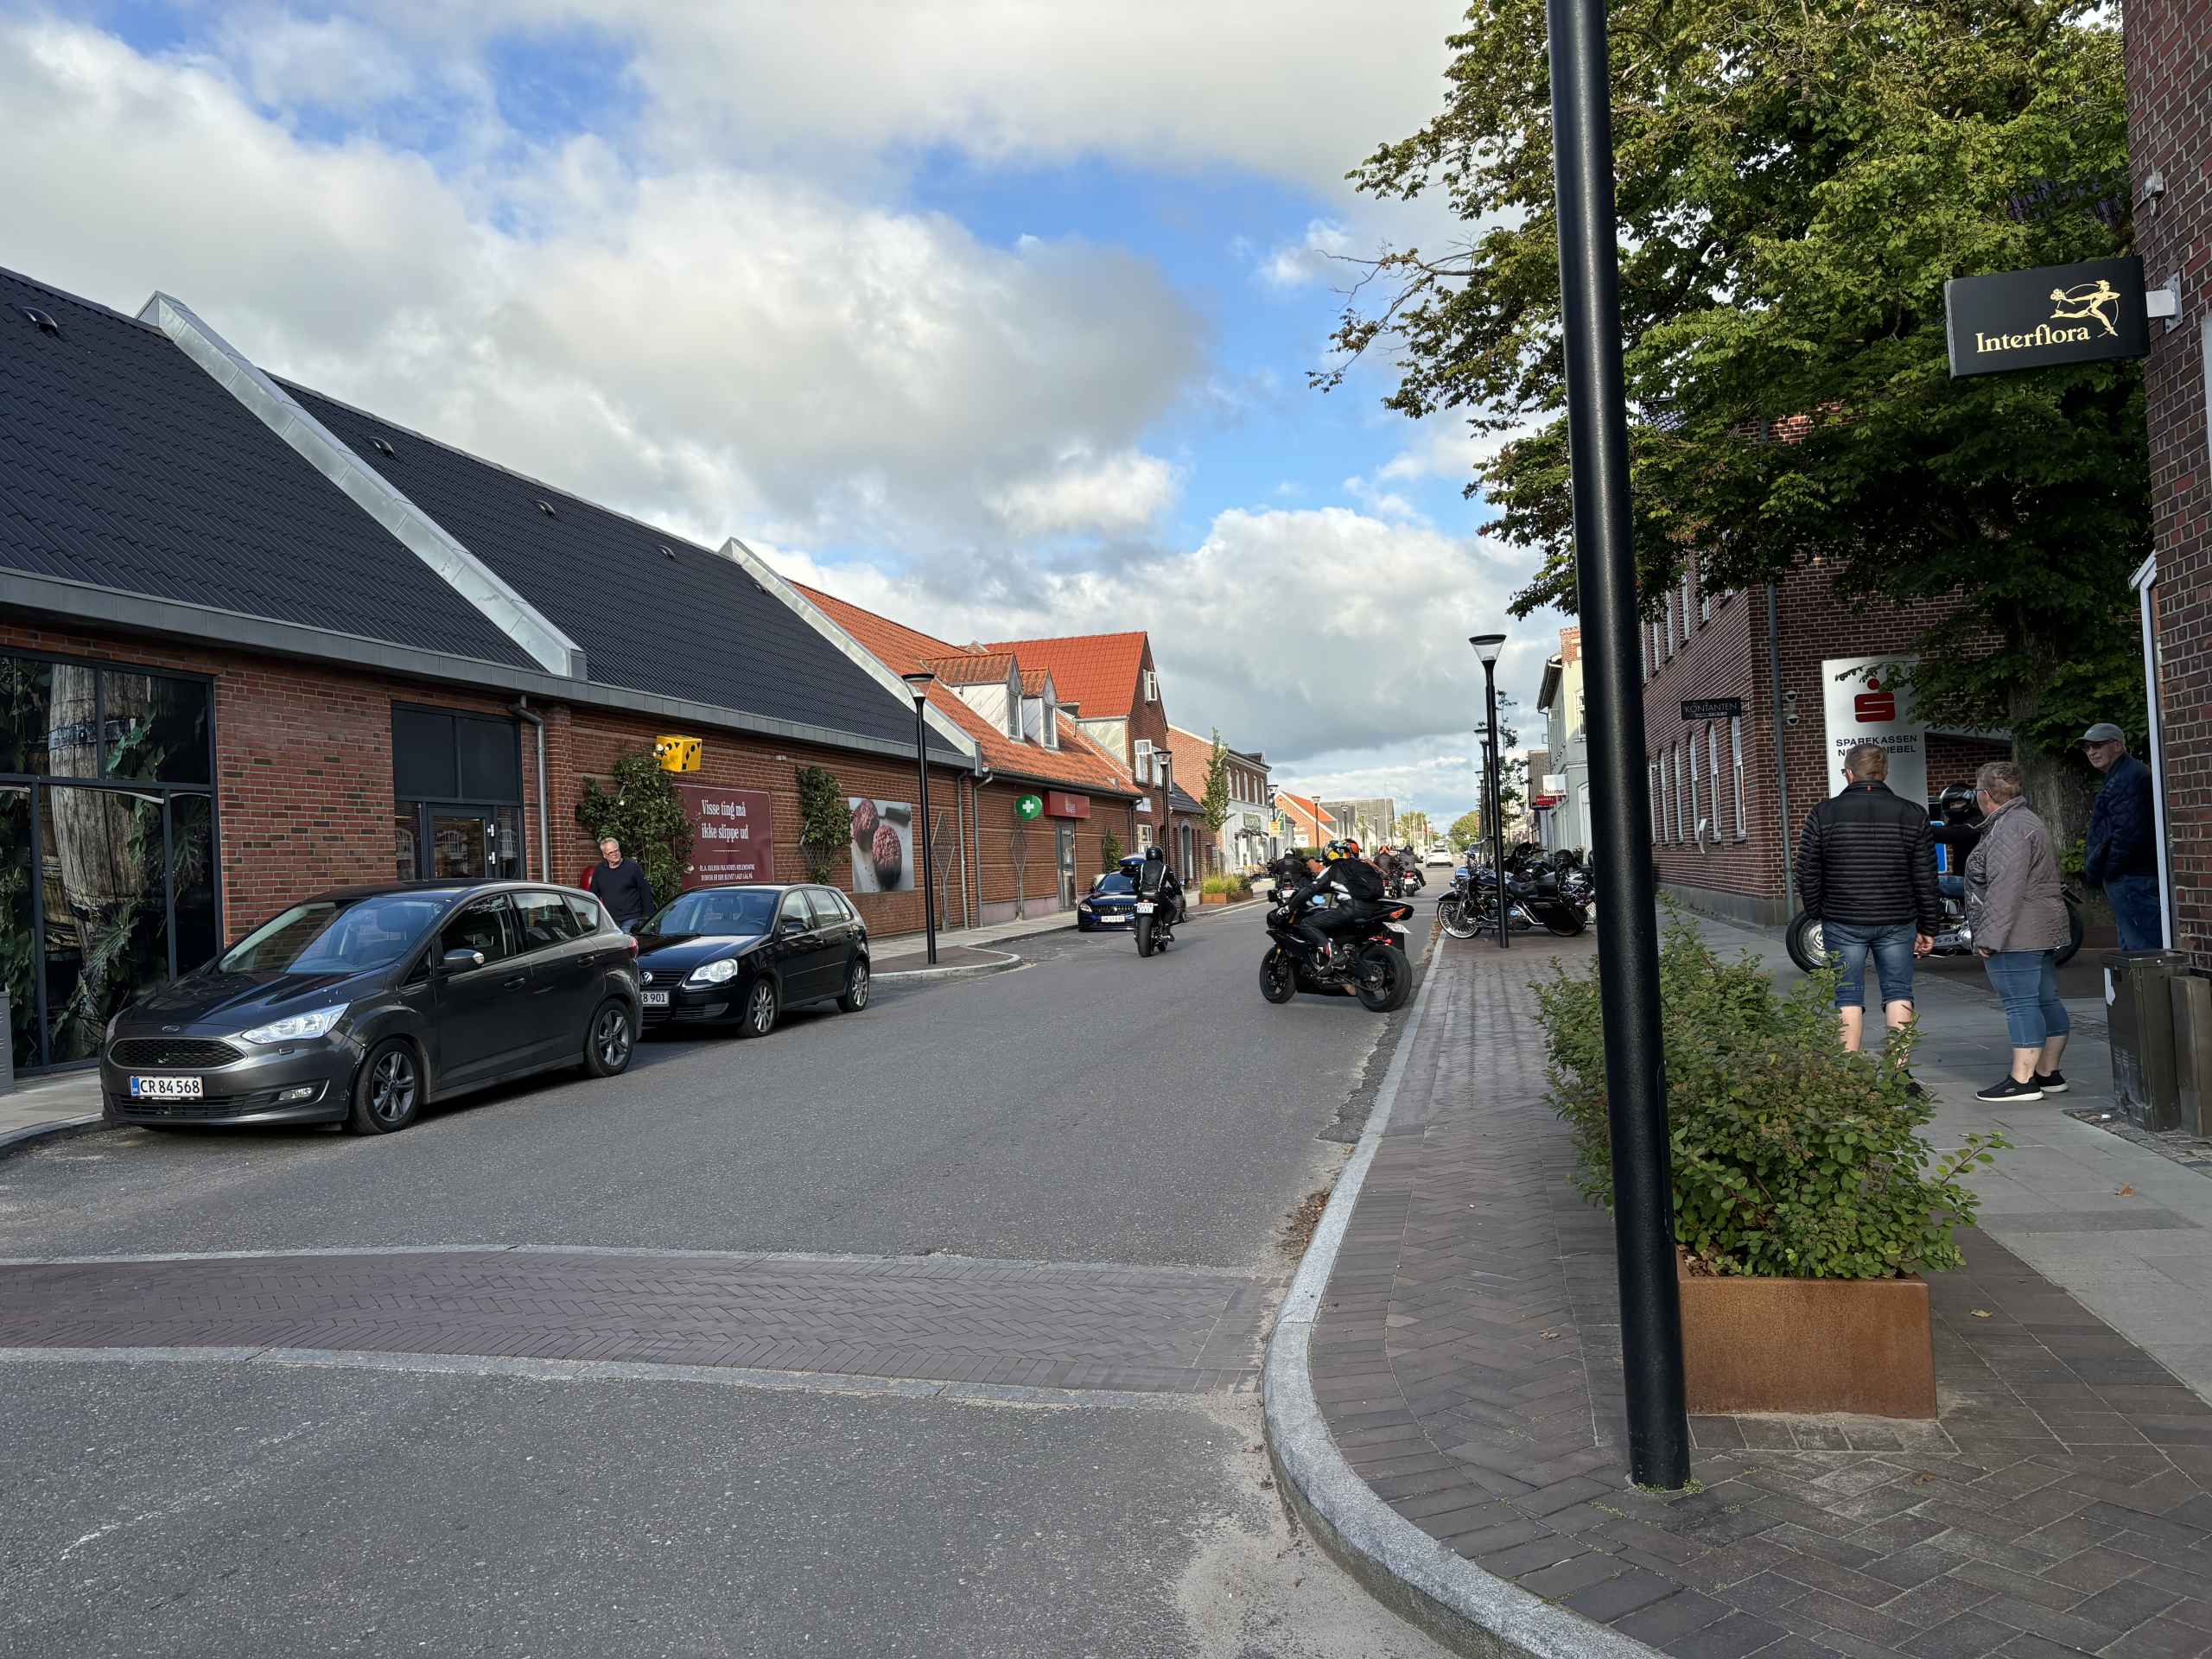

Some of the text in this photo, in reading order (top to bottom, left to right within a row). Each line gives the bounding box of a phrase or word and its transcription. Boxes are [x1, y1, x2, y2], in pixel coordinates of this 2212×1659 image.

[1975, 323, 2091, 353] Interflora
[1686, 702, 1737, 713] KONTANTEN
[1835, 734, 1917, 747] SPAREKASSEN
[702, 799, 747, 820] Visse ting må
[702, 823, 749, 843] ikke slippe ud
[650, 994, 665, 1002] 901
[140, 1080, 156, 1093] CR
[158, 1080, 174, 1094] 84
[176, 1080, 200, 1094] 568
